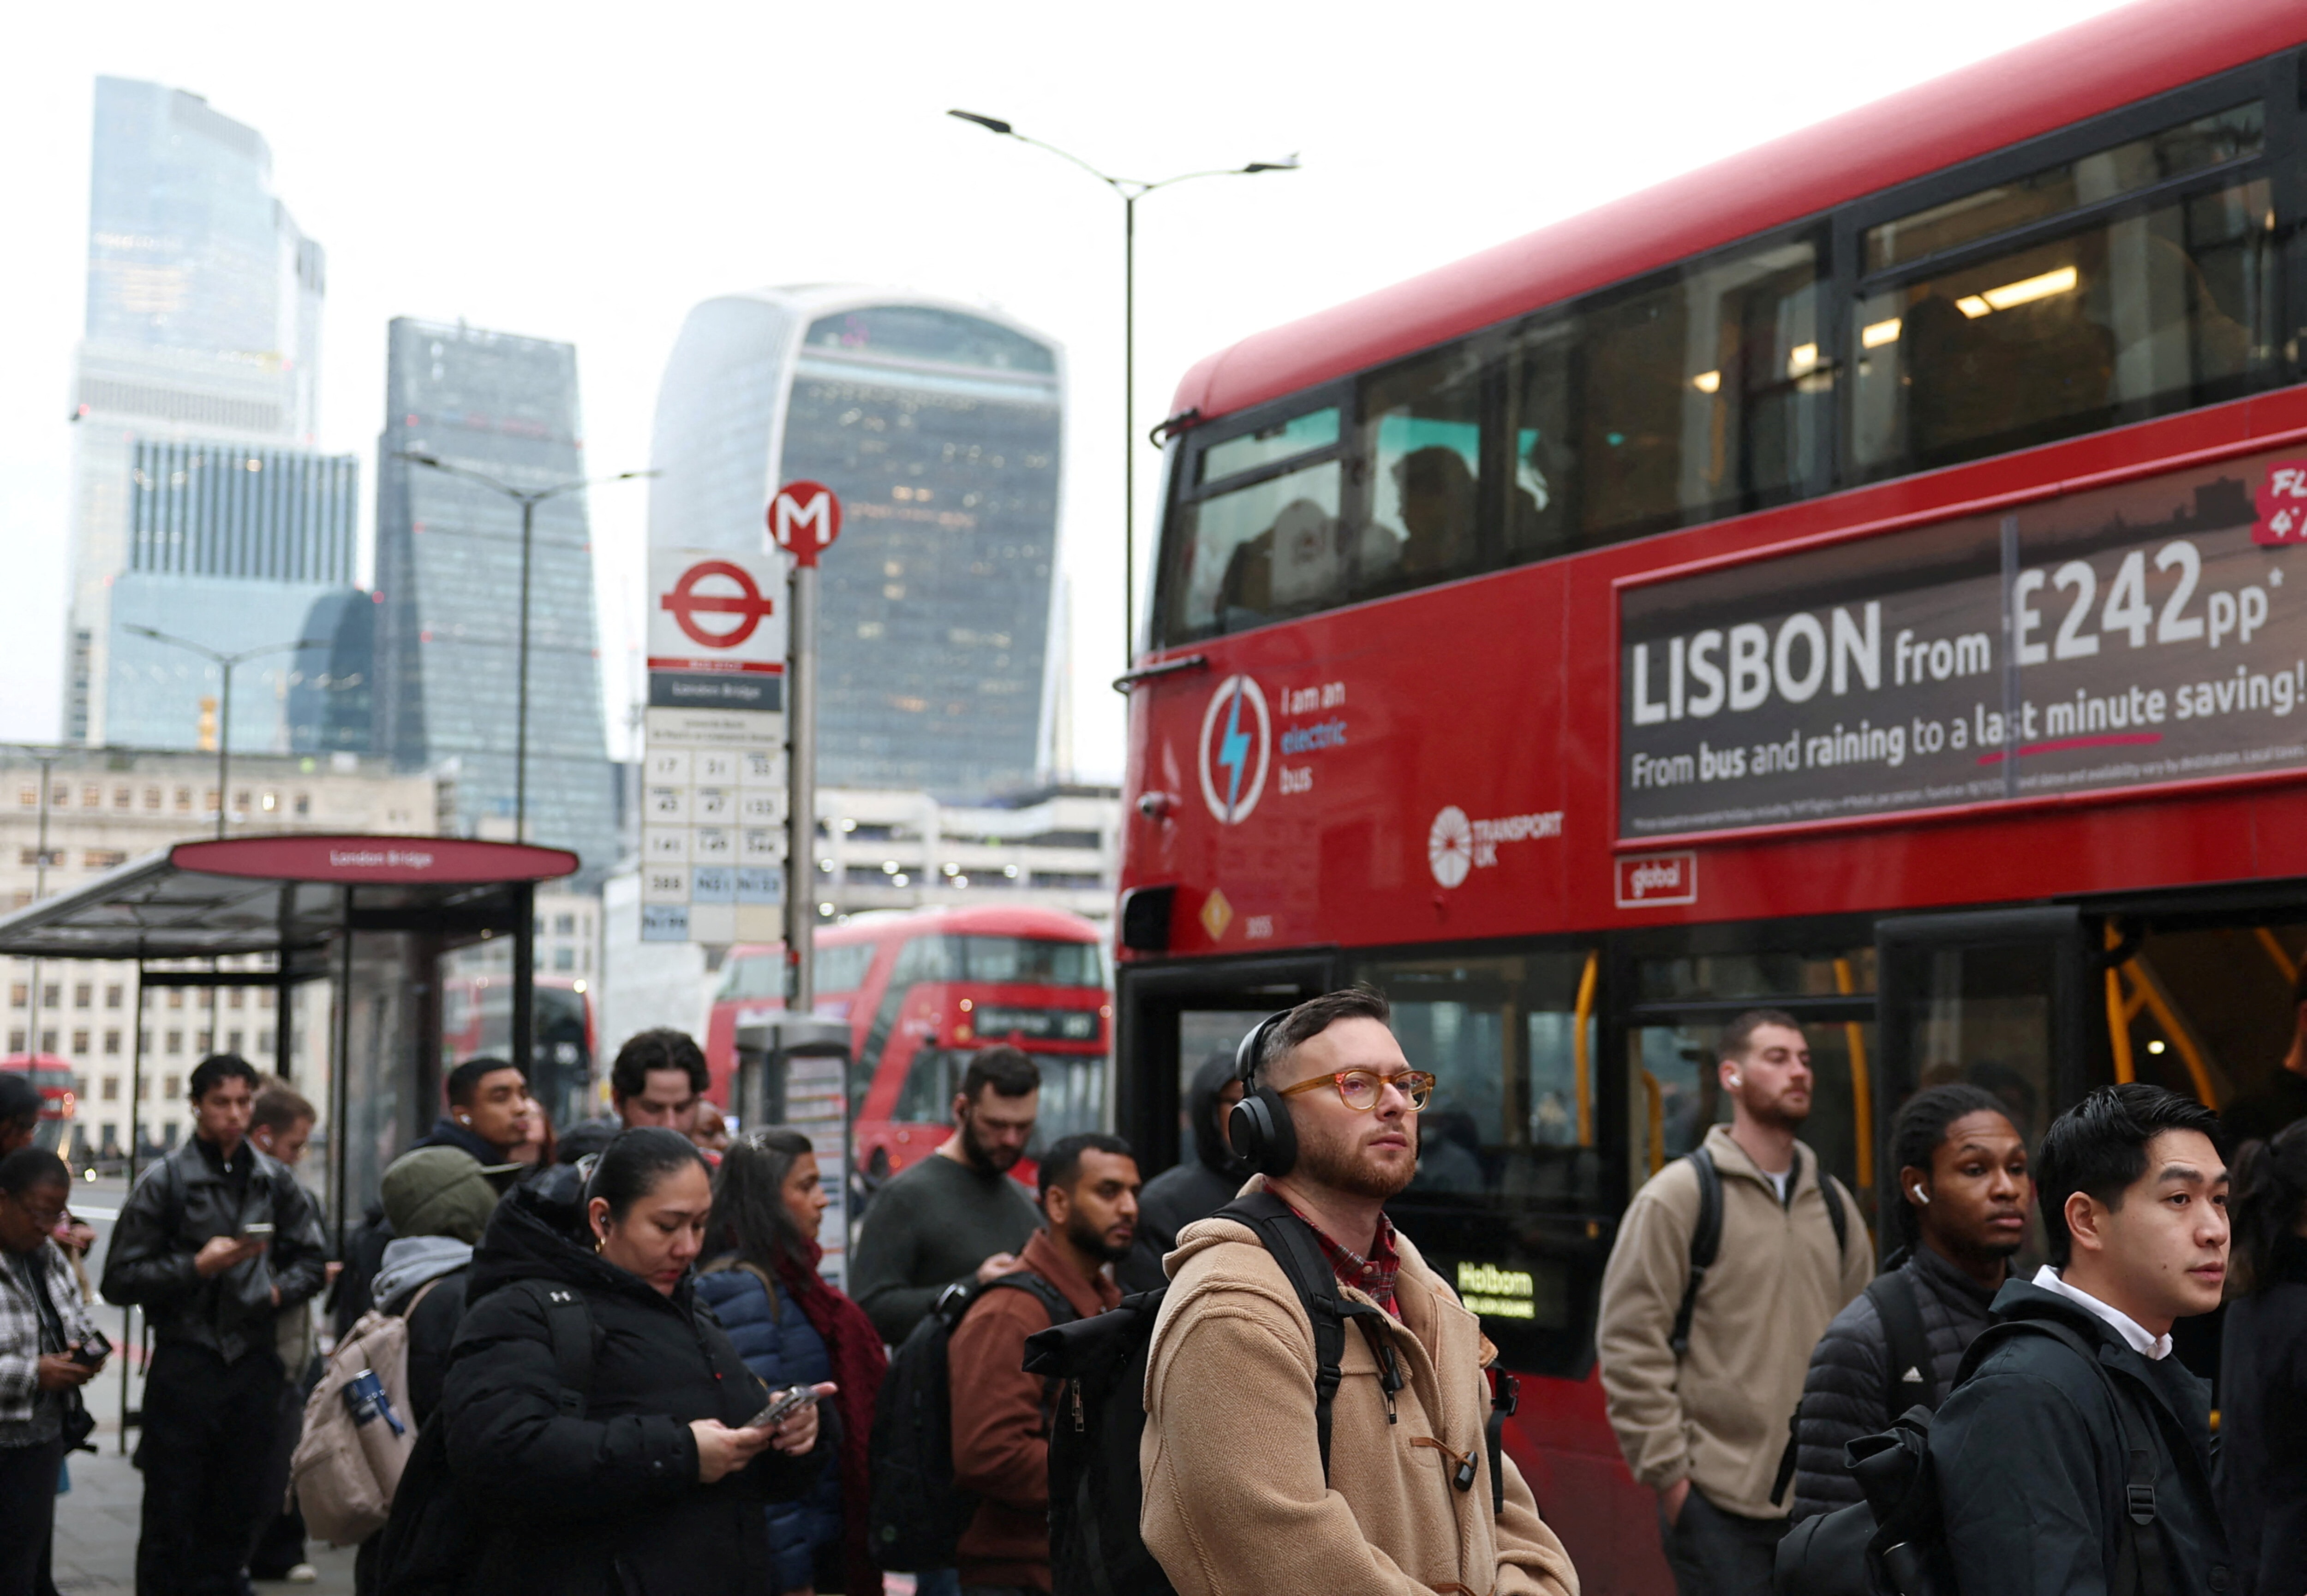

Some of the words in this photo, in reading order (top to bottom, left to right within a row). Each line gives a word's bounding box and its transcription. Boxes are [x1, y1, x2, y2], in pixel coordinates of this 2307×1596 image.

[775, 490, 831, 546] M
[1632, 600, 1882, 726] LISBON
[1894, 630, 1991, 686] from
[1280, 686, 1290, 716] I
[1291, 686, 1320, 715] am
[1321, 680, 1346, 709] an
[1280, 716, 1348, 756] electric
[1631, 752, 1695, 790] From
[1699, 741, 1746, 782] bus
[1751, 728, 1800, 776] and
[1805, 720, 1905, 767] raining
[1913, 716, 1944, 755] to
[1950, 717, 1968, 750] a
[2045, 688, 2167, 737] minute
[2175, 660, 2307, 718] saving!
[1279, 763, 1313, 796] bus
[1472, 810, 1565, 842] TRANSPORT
[1474, 841, 1499, 868] UK
[1630, 859, 1681, 898] global
[1458, 1261, 1533, 1298] Holborn
